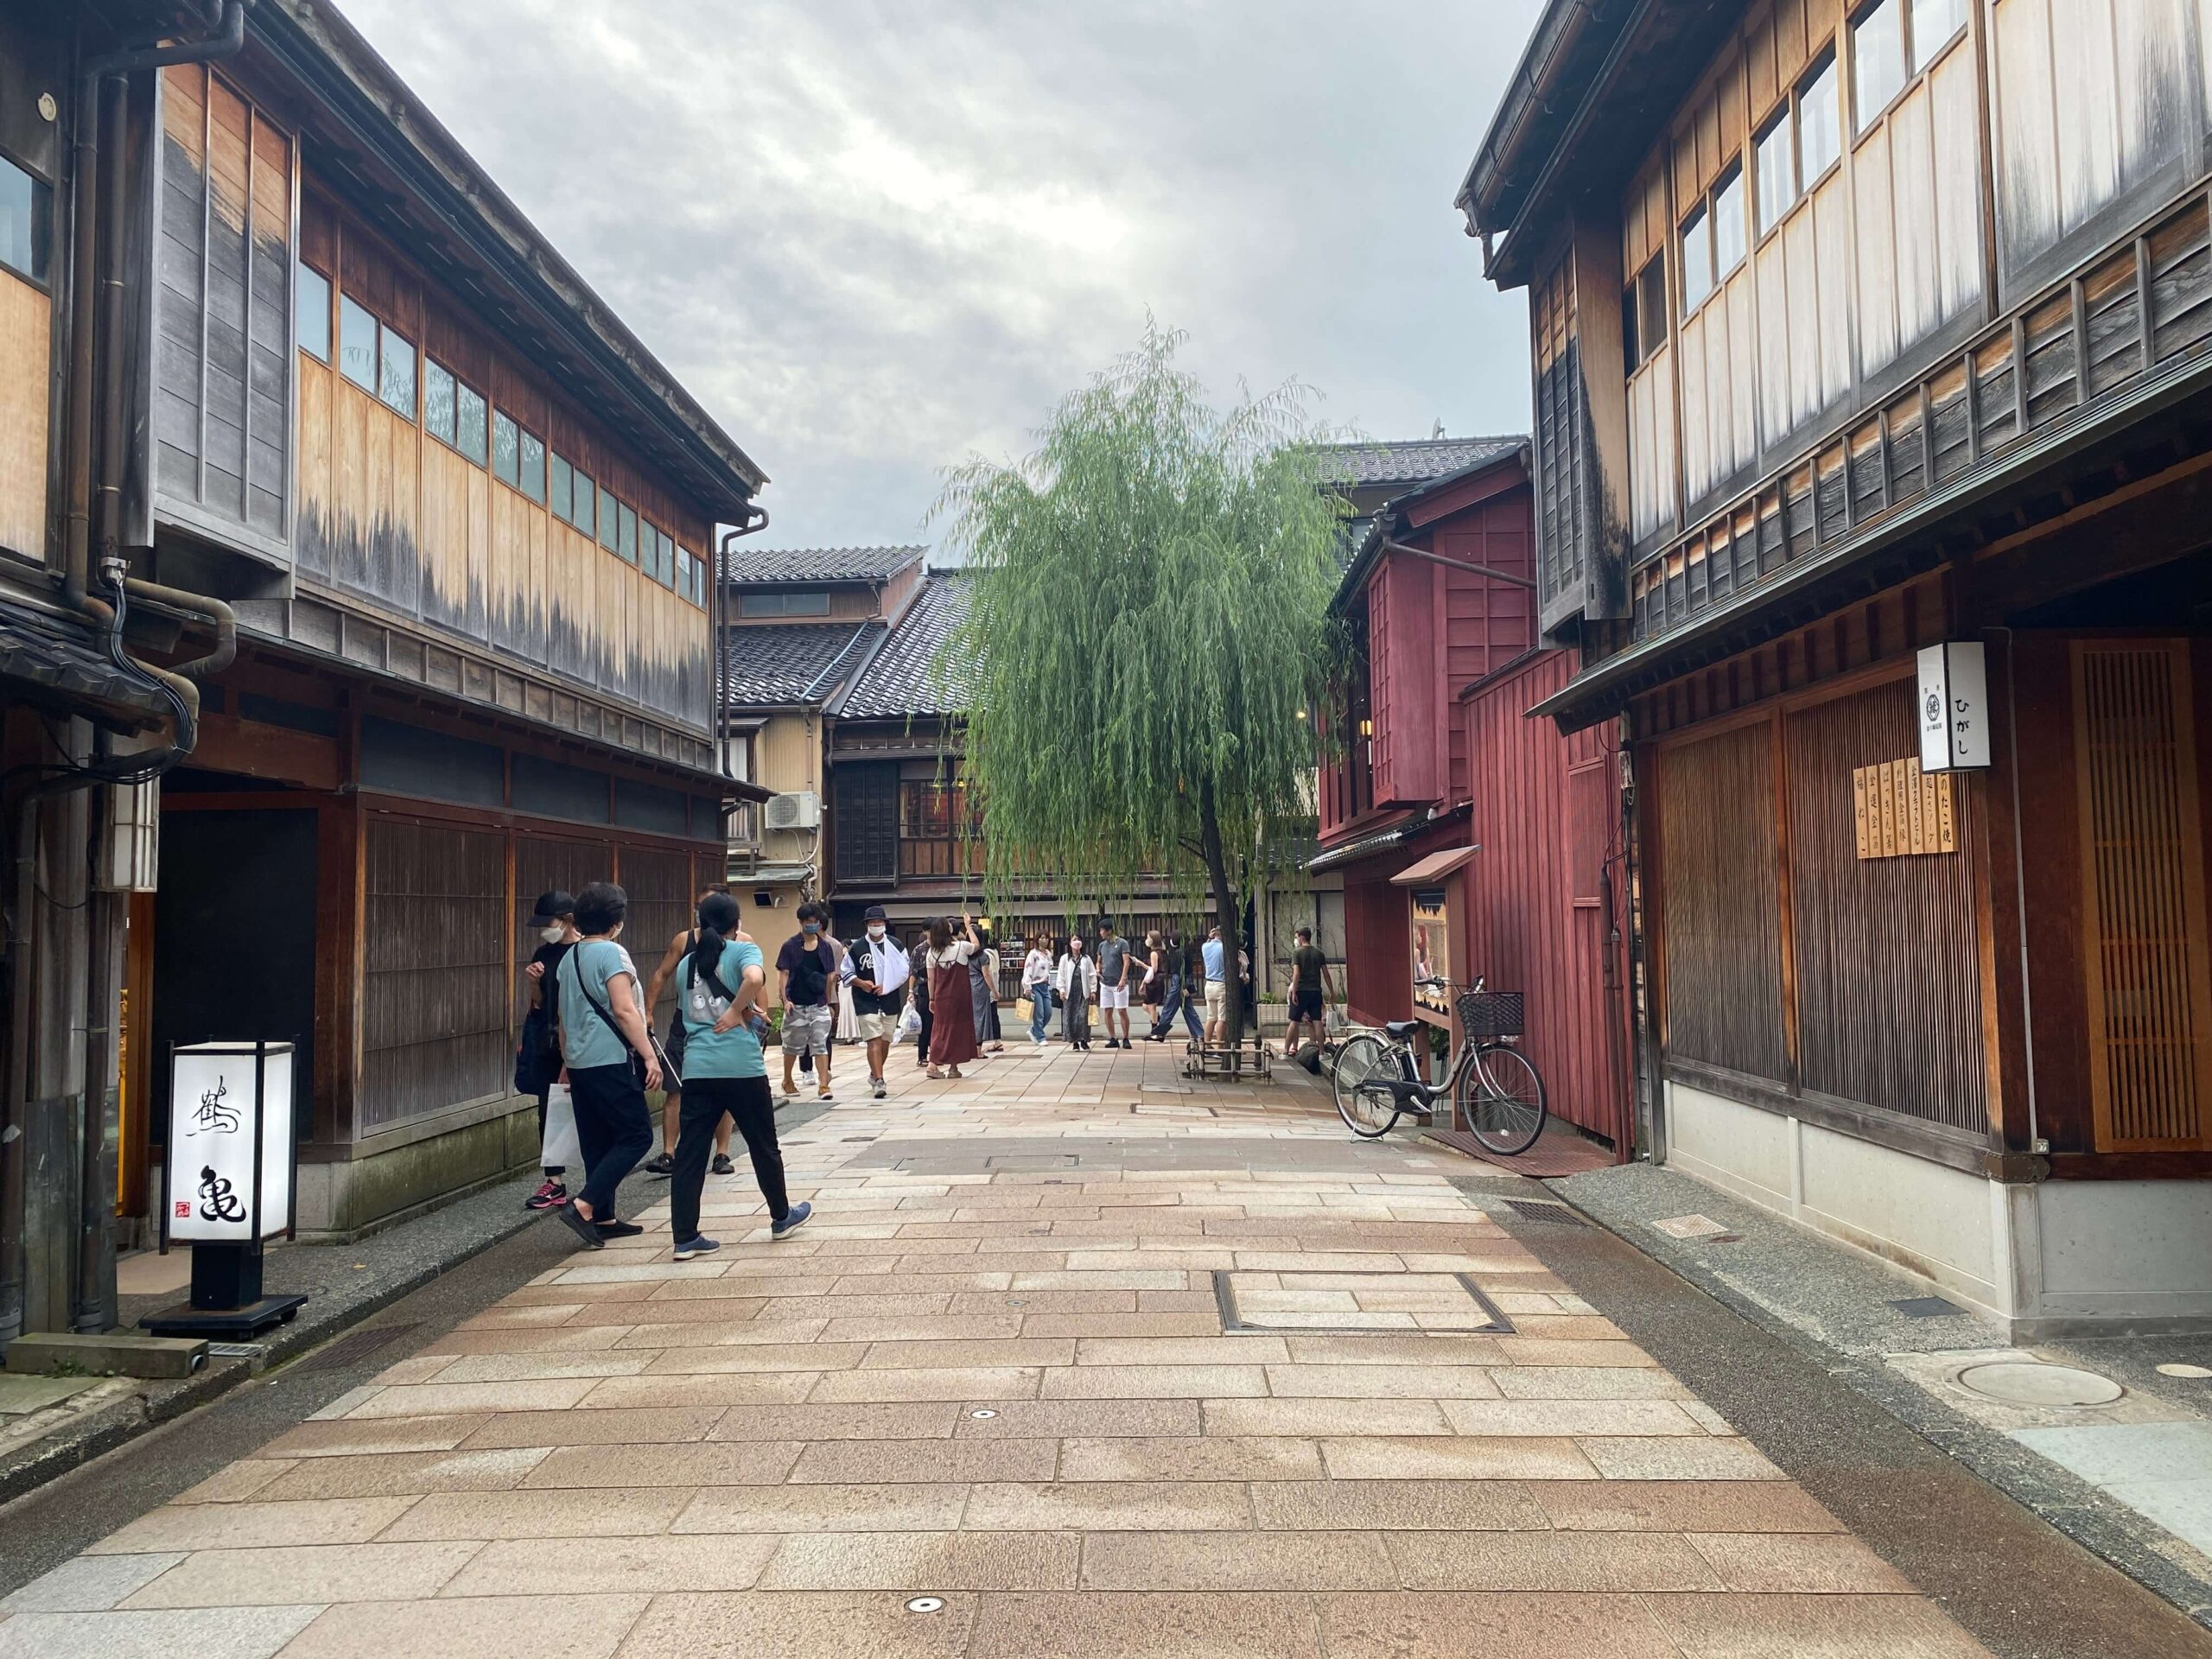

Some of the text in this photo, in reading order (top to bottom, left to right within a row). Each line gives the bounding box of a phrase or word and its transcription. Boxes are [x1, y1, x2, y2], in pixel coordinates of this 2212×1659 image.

[1955, 699, 1970, 754] ひがし
[1940, 773, 1952, 842] のたこ焼
